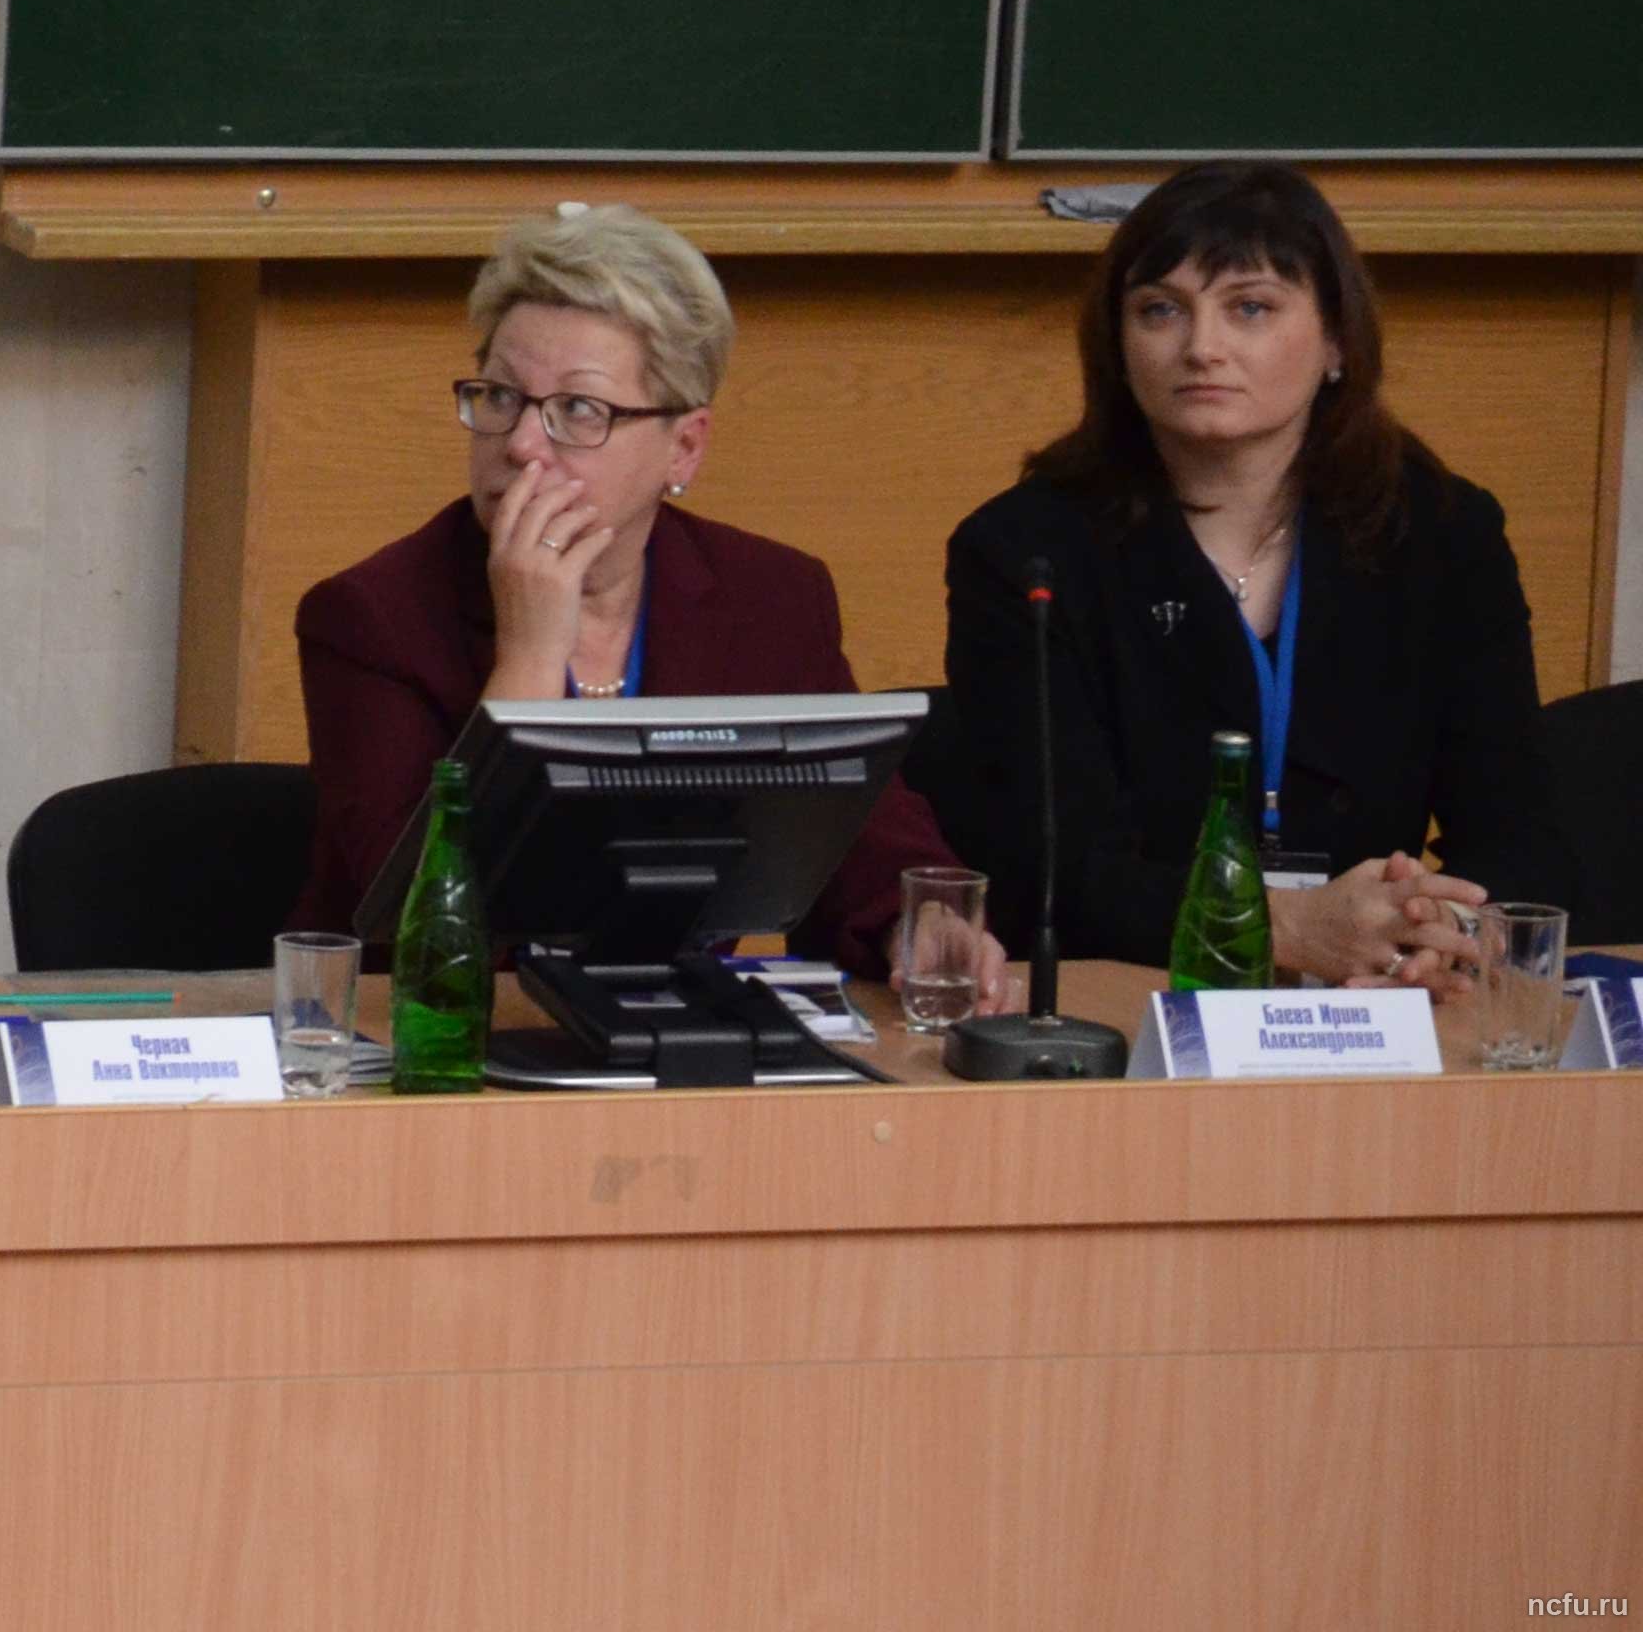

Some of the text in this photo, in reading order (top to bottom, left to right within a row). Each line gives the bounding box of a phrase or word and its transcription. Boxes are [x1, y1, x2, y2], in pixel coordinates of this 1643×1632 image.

[1262, 1003, 1371, 1029] Баева Ирина
[131, 1034, 191, 1060] Черная
[1259, 1028, 1385, 1054] Александровна
[93, 1059, 240, 1084] Анна Викторовна
